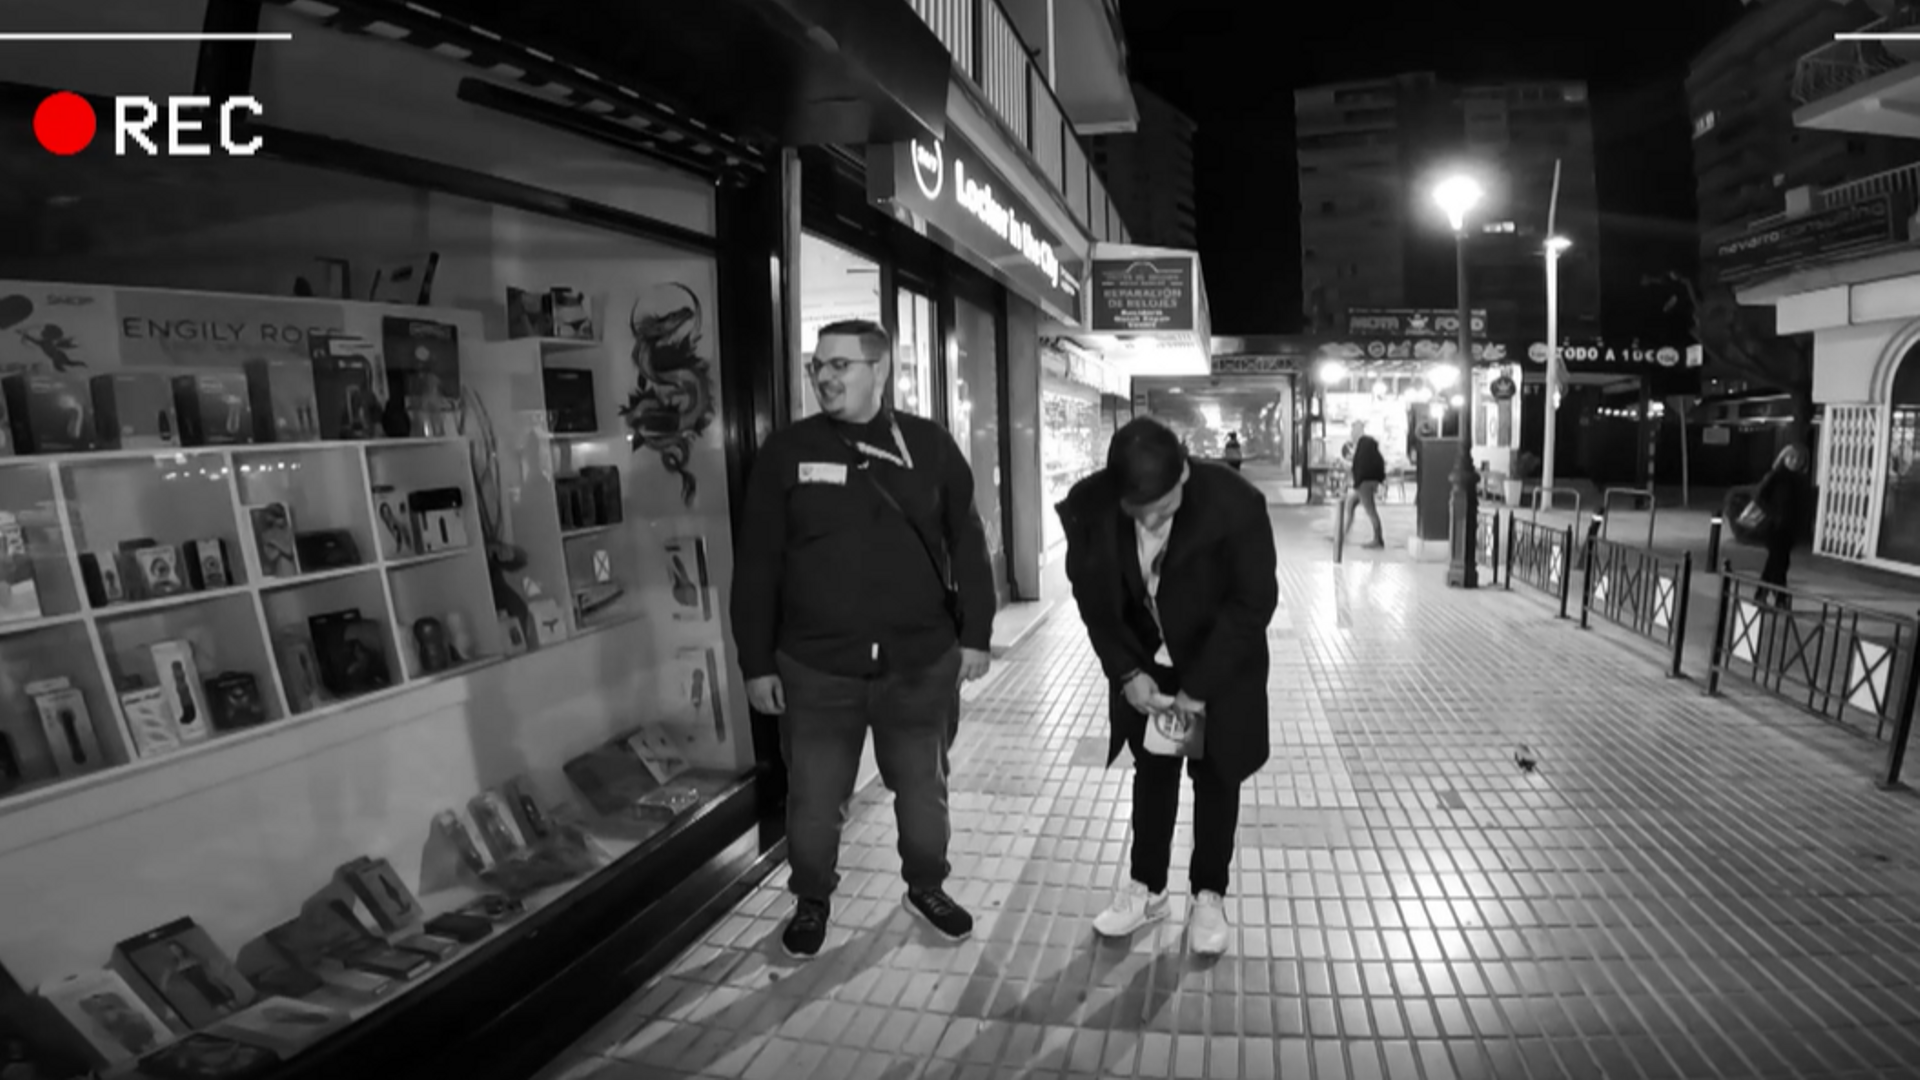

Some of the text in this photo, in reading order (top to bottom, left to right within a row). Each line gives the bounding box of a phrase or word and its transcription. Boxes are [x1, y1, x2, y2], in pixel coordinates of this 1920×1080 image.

[955, 159, 1008, 239] Locker
[1009, 207, 1022, 250] in
[1022, 222, 1041, 266] the
[1041, 240, 1058, 288] City
[122, 316, 246, 341] ENGILY
[1434, 316, 1485, 331] FOD
[1556, 347, 1598, 361] TODO
[1605, 347, 1616, 361] A
